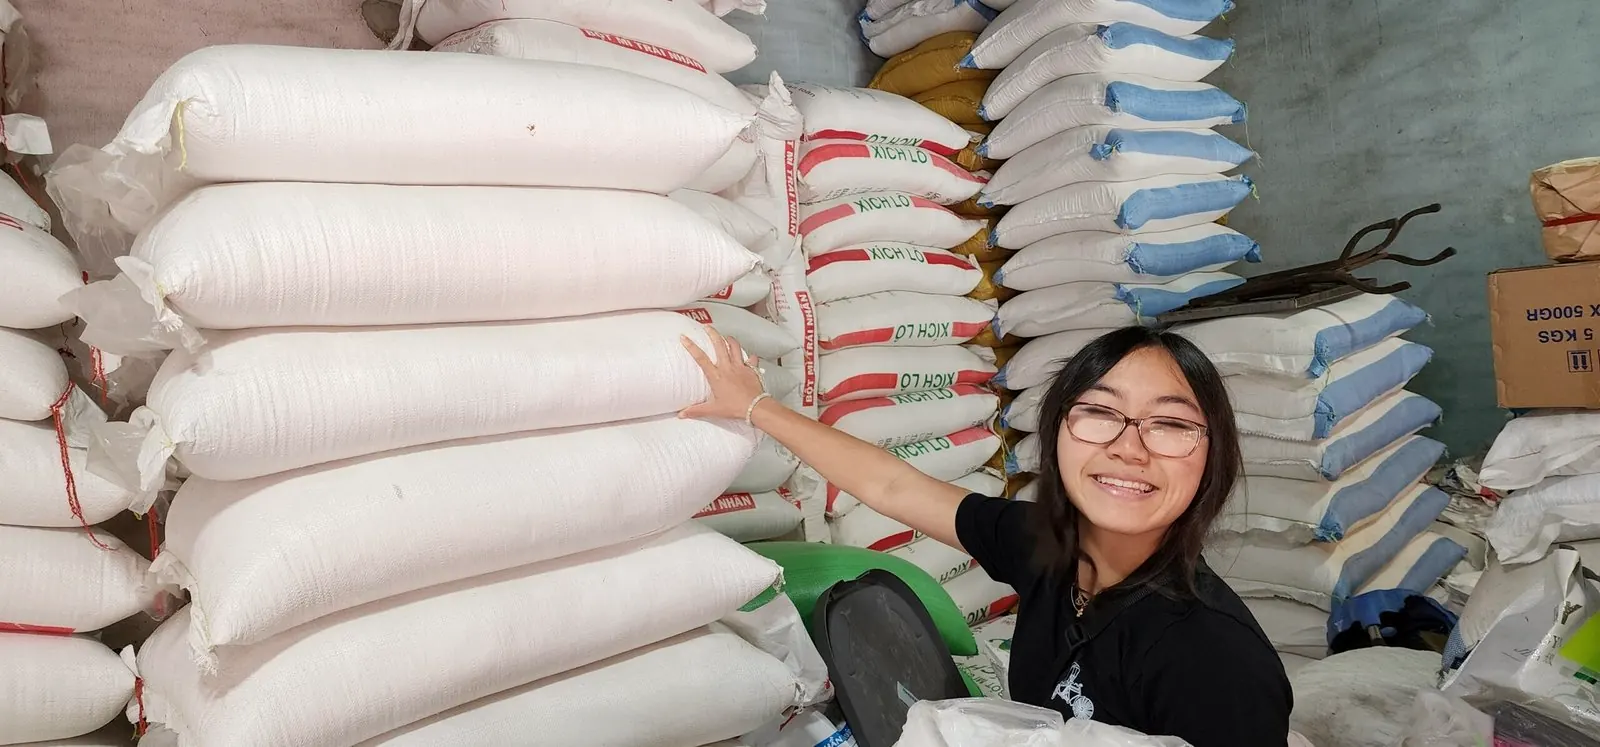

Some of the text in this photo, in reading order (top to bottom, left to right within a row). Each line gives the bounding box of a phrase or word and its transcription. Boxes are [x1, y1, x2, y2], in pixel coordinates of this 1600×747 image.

[1526, 303, 1600, 321] X 500GR
[1538, 328, 1593, 343] 5 KGS
